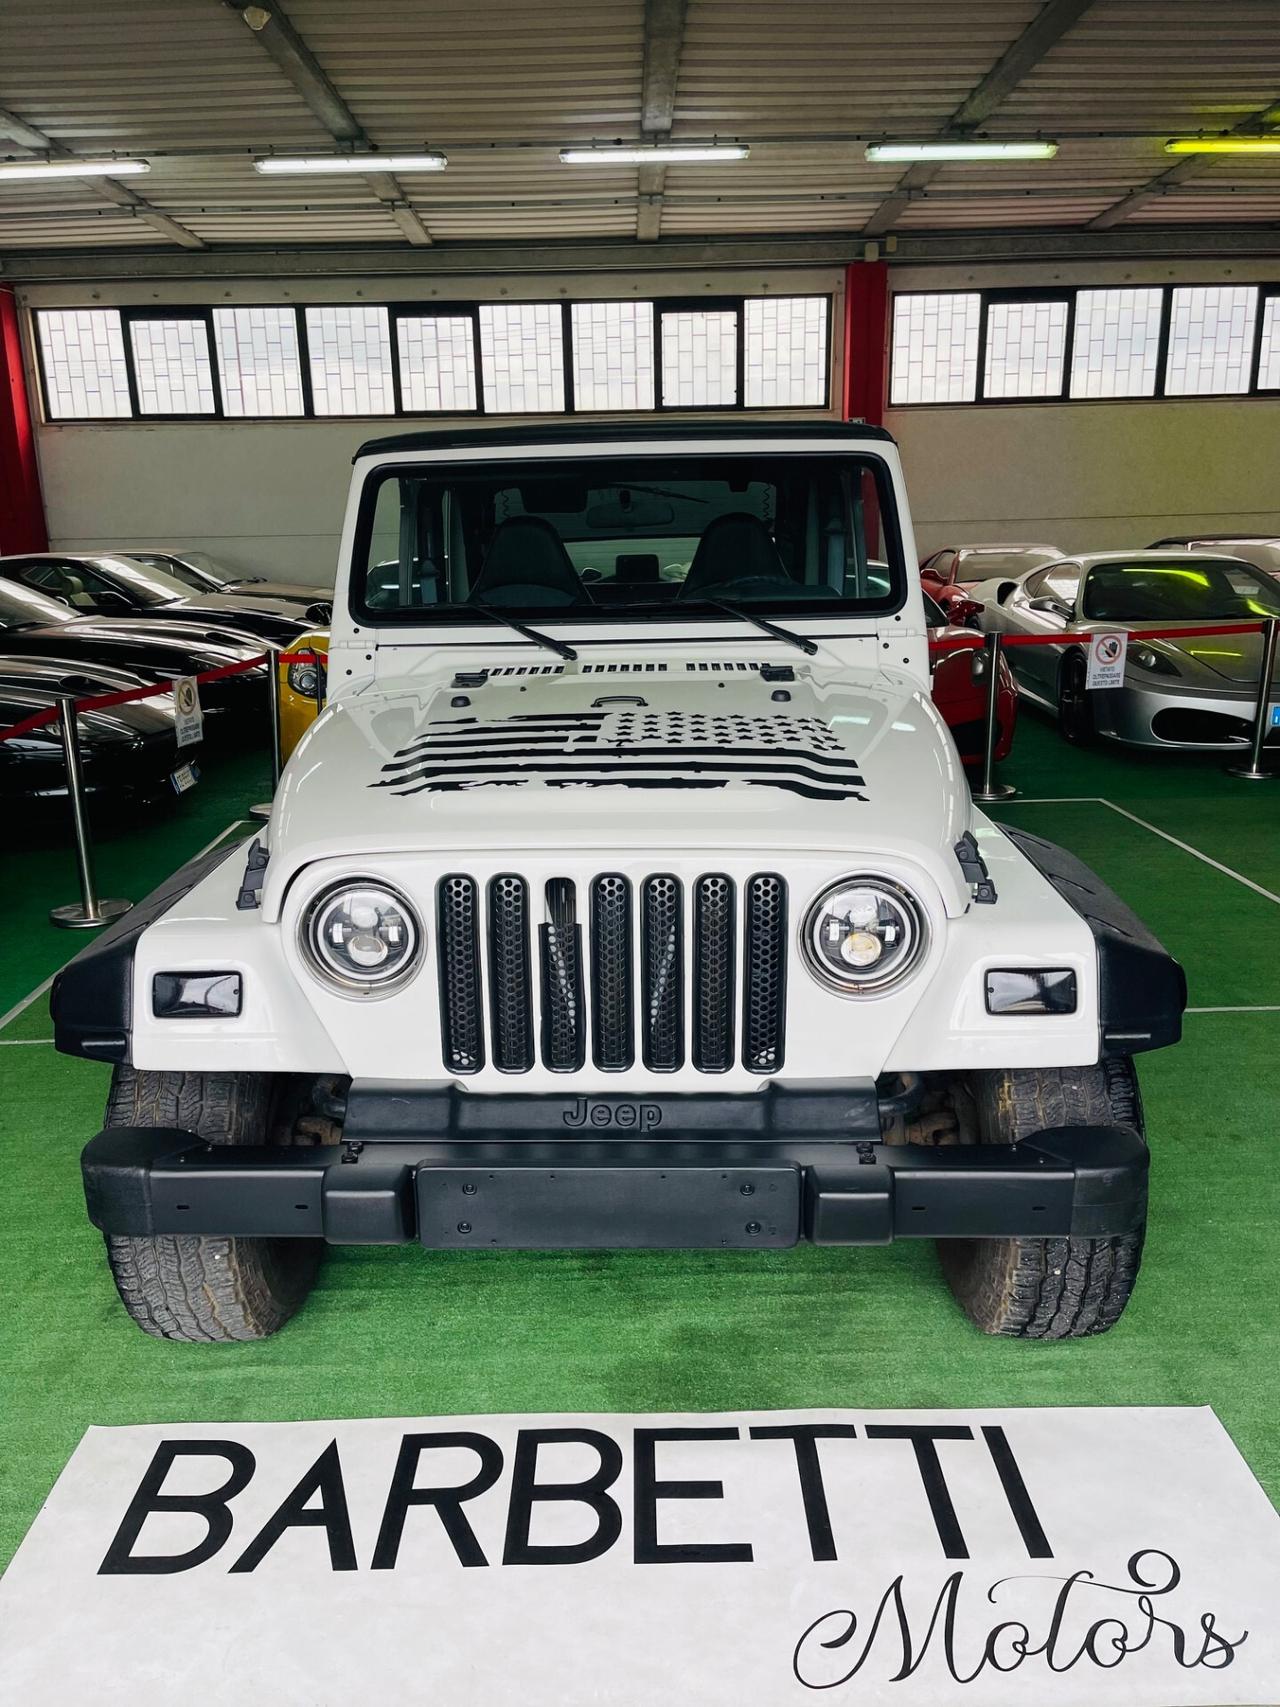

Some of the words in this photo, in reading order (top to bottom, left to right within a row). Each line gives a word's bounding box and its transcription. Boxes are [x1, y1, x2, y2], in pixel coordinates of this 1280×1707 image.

[562, 1097, 663, 1132] Jeep
[97, 1424, 1054, 1576] BARBETTI
[793, 1549, 1249, 1690] Motors
